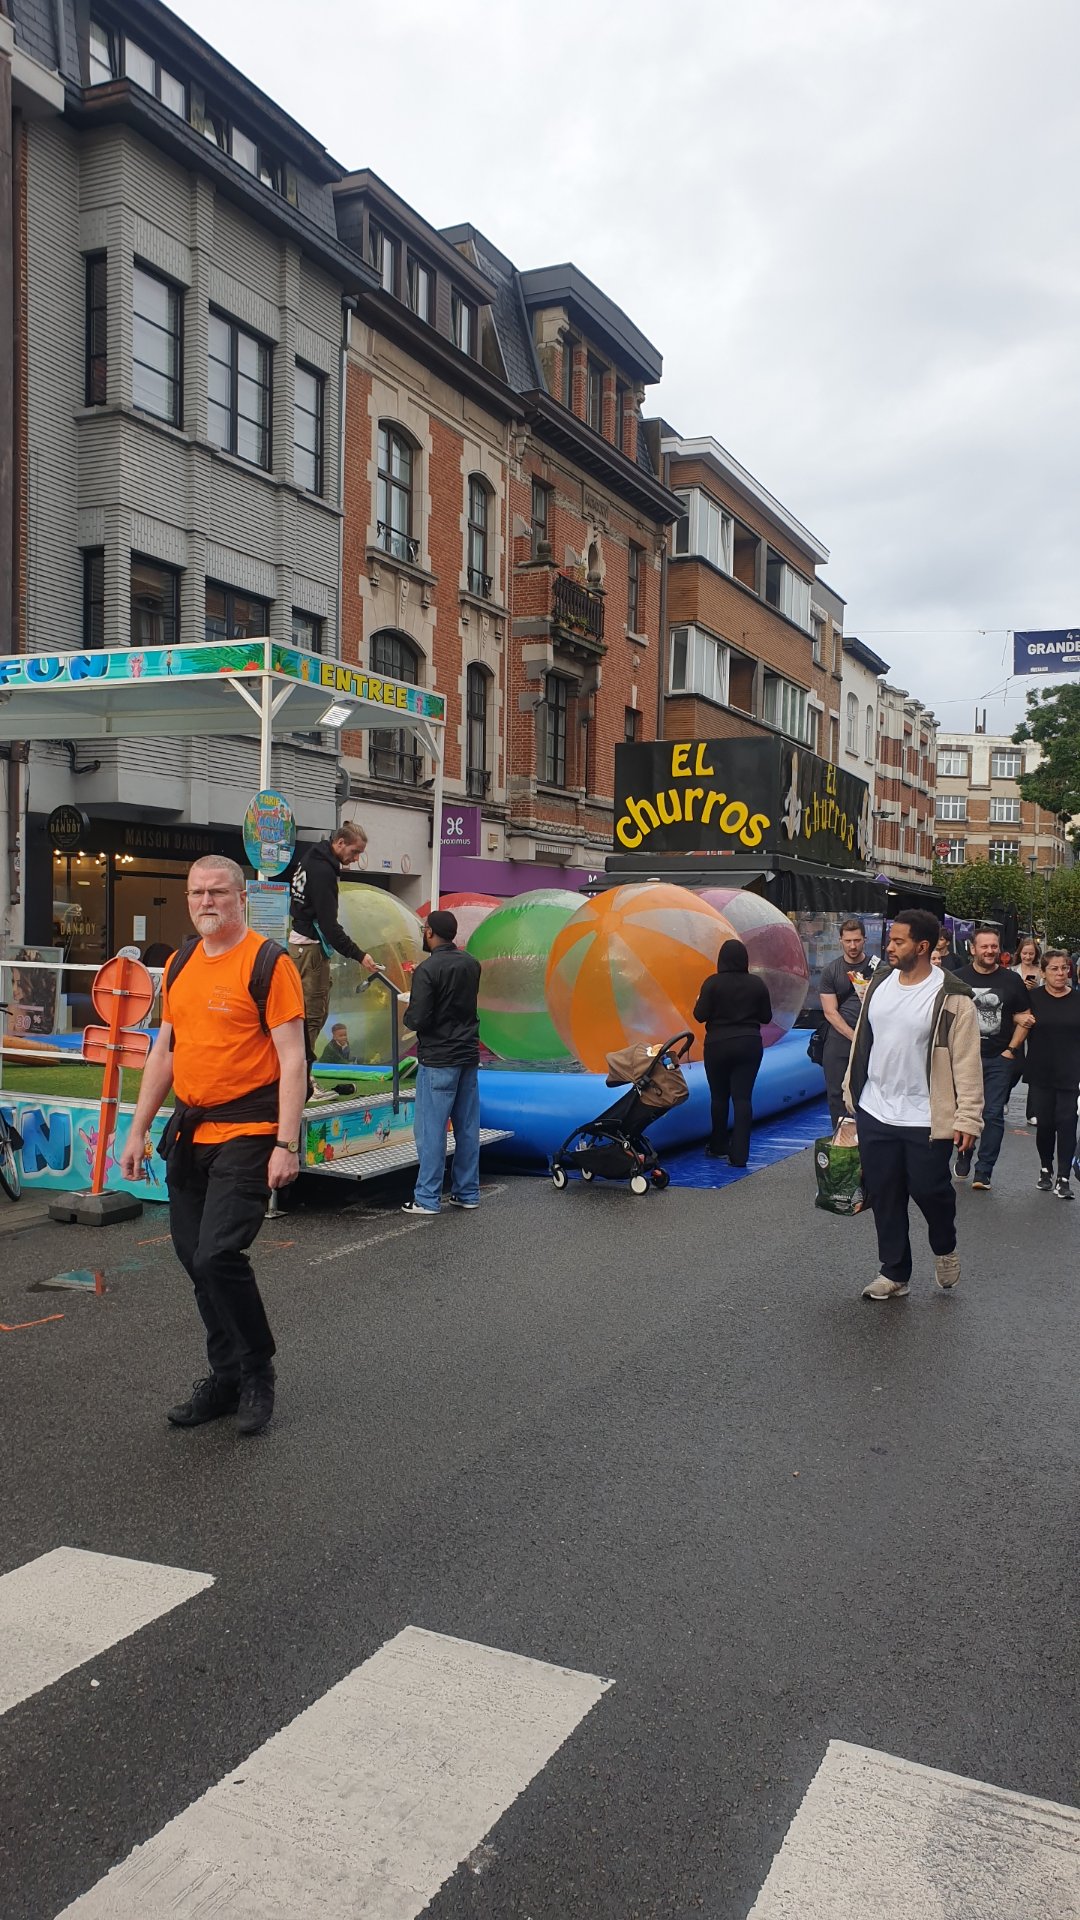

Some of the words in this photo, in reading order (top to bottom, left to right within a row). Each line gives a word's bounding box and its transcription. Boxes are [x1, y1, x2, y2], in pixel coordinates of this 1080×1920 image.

[1027, 641, 1080, 655] GRANDE
[1066, 631, 1073, 640] 4
[0, 653, 110, 685] FUN
[321, 662, 407, 709] ENTREE
[671, 742, 714, 777] EL
[826, 763, 837, 796] EL
[260, 794, 280, 806] TARIF
[616, 787, 771, 848] churros
[805, 791, 854, 851] churros
[125, 828, 169, 848] MAISON
[440, 838, 471, 846] proximus
